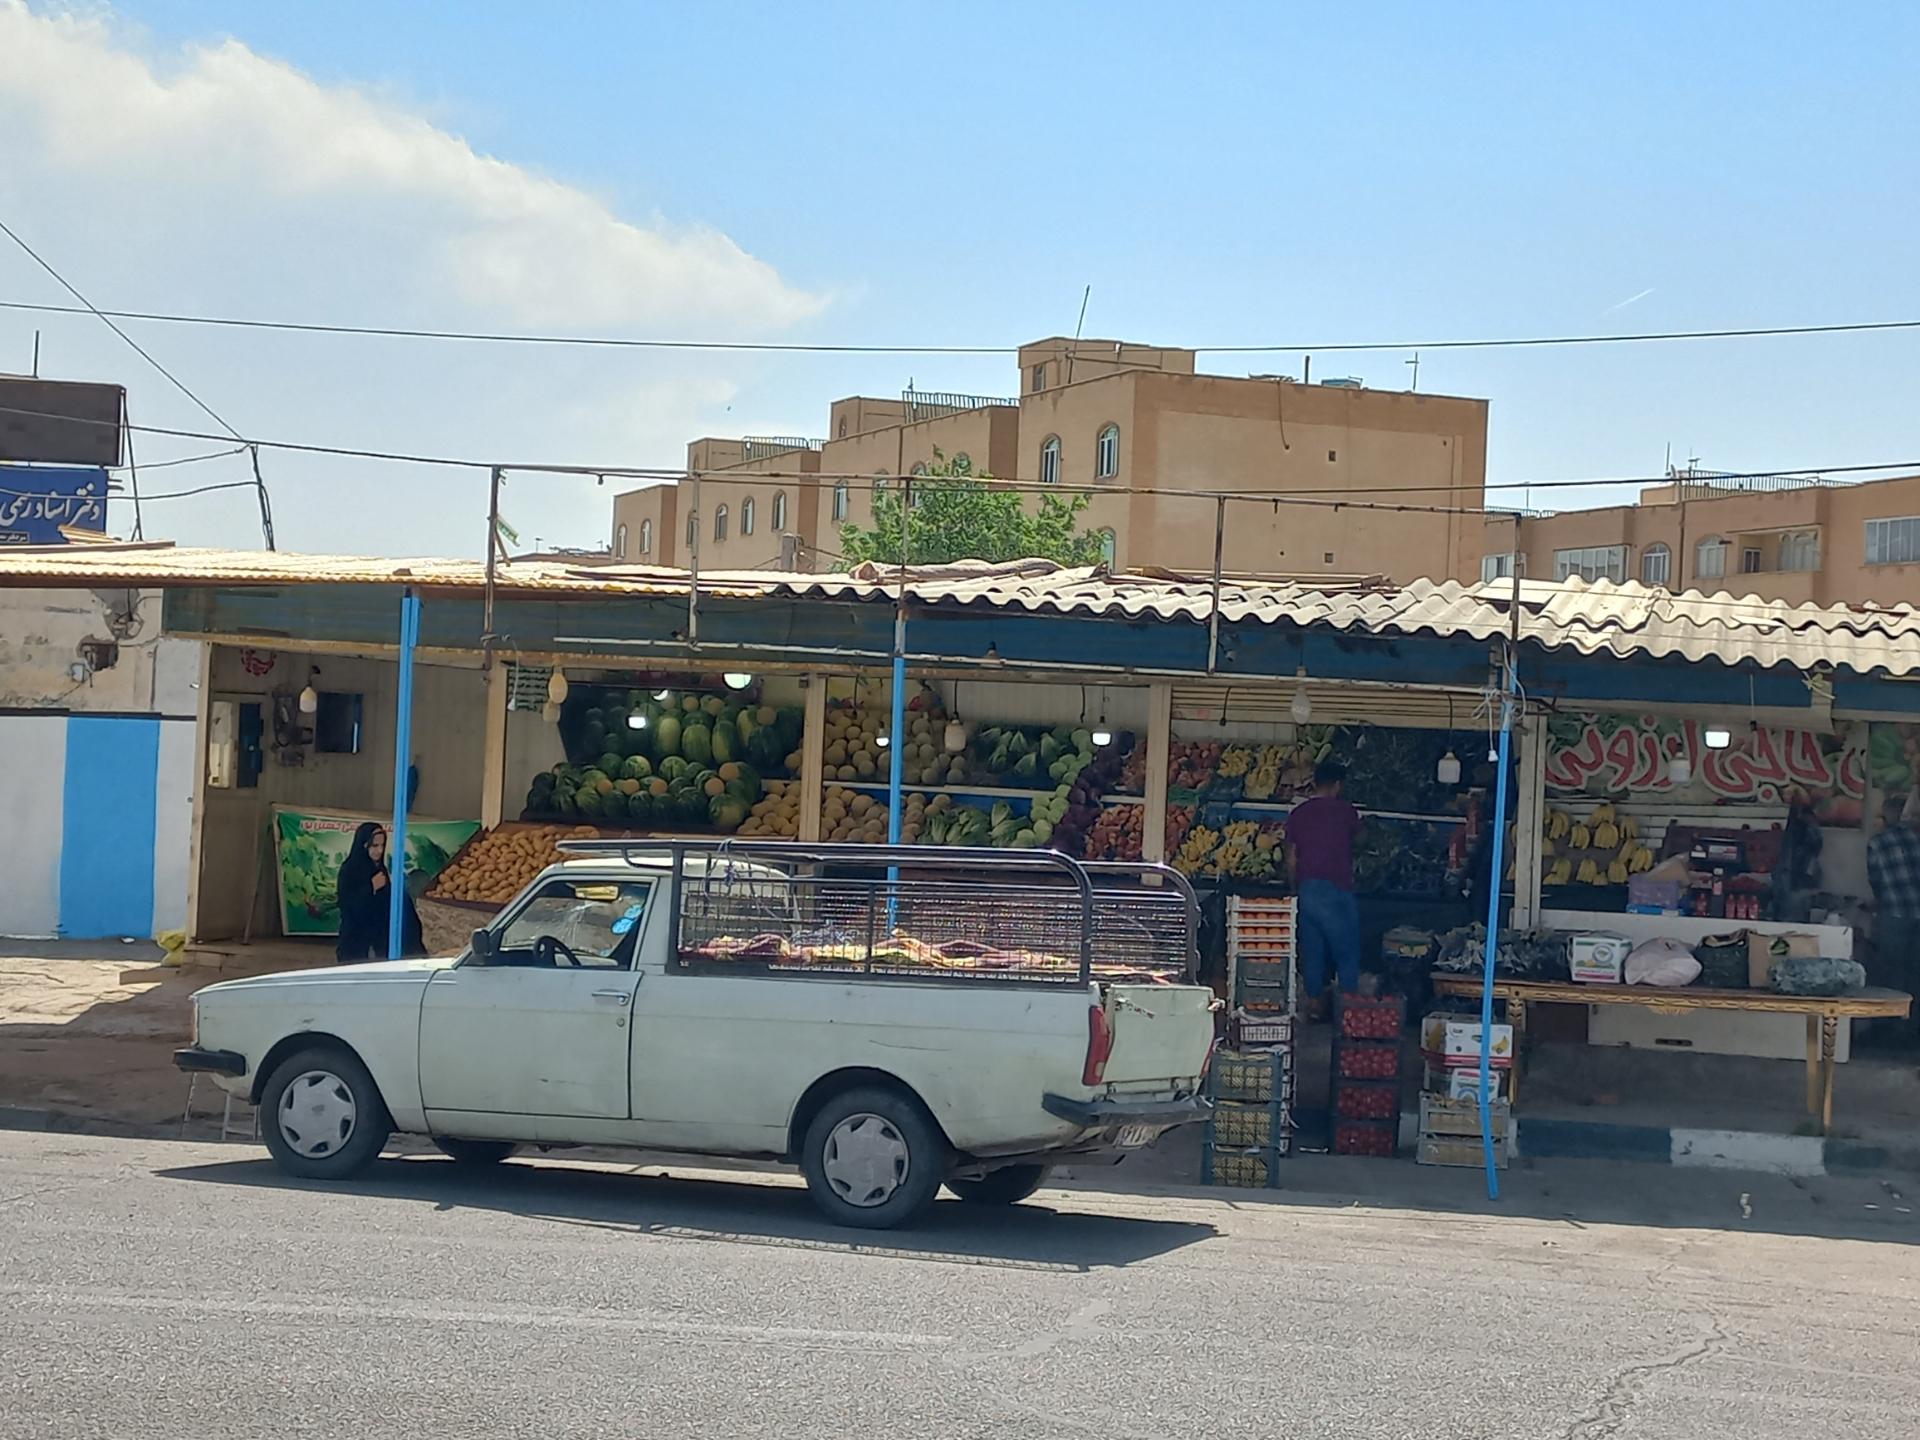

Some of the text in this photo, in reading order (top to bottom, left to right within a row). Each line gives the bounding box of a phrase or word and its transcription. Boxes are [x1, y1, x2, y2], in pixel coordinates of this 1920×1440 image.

[0, 483, 100, 527] دفتر اسناد رسمی
